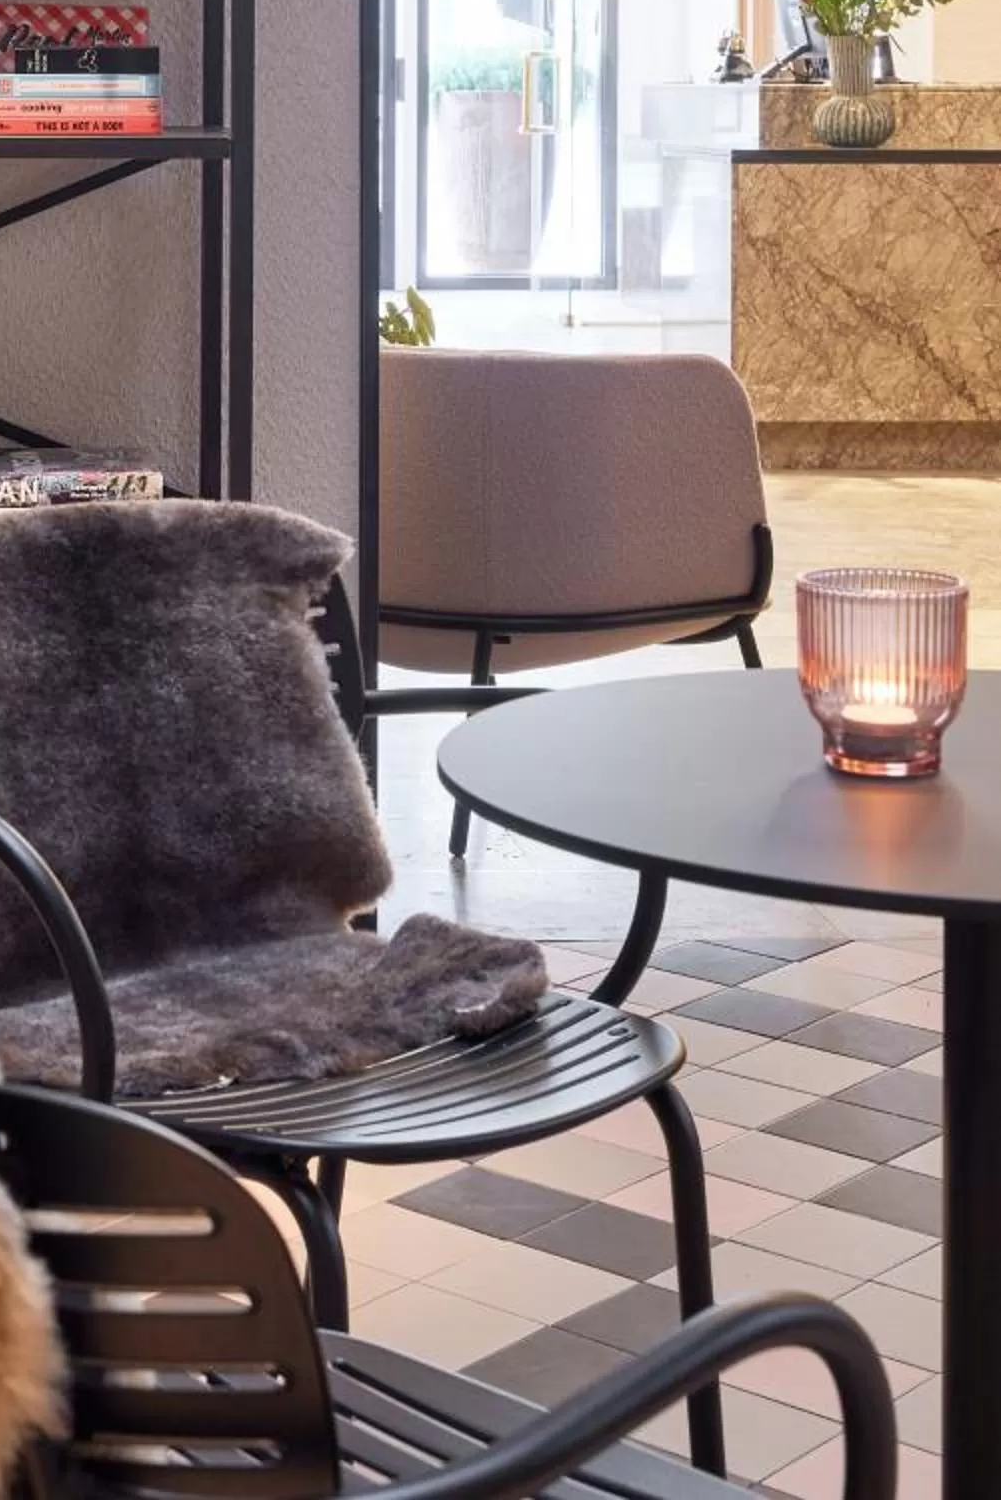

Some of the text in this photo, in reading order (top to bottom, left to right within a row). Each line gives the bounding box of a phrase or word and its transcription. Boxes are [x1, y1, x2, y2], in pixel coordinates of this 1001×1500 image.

[36, 121, 124, 131] THIS IS NOT A BOOK
